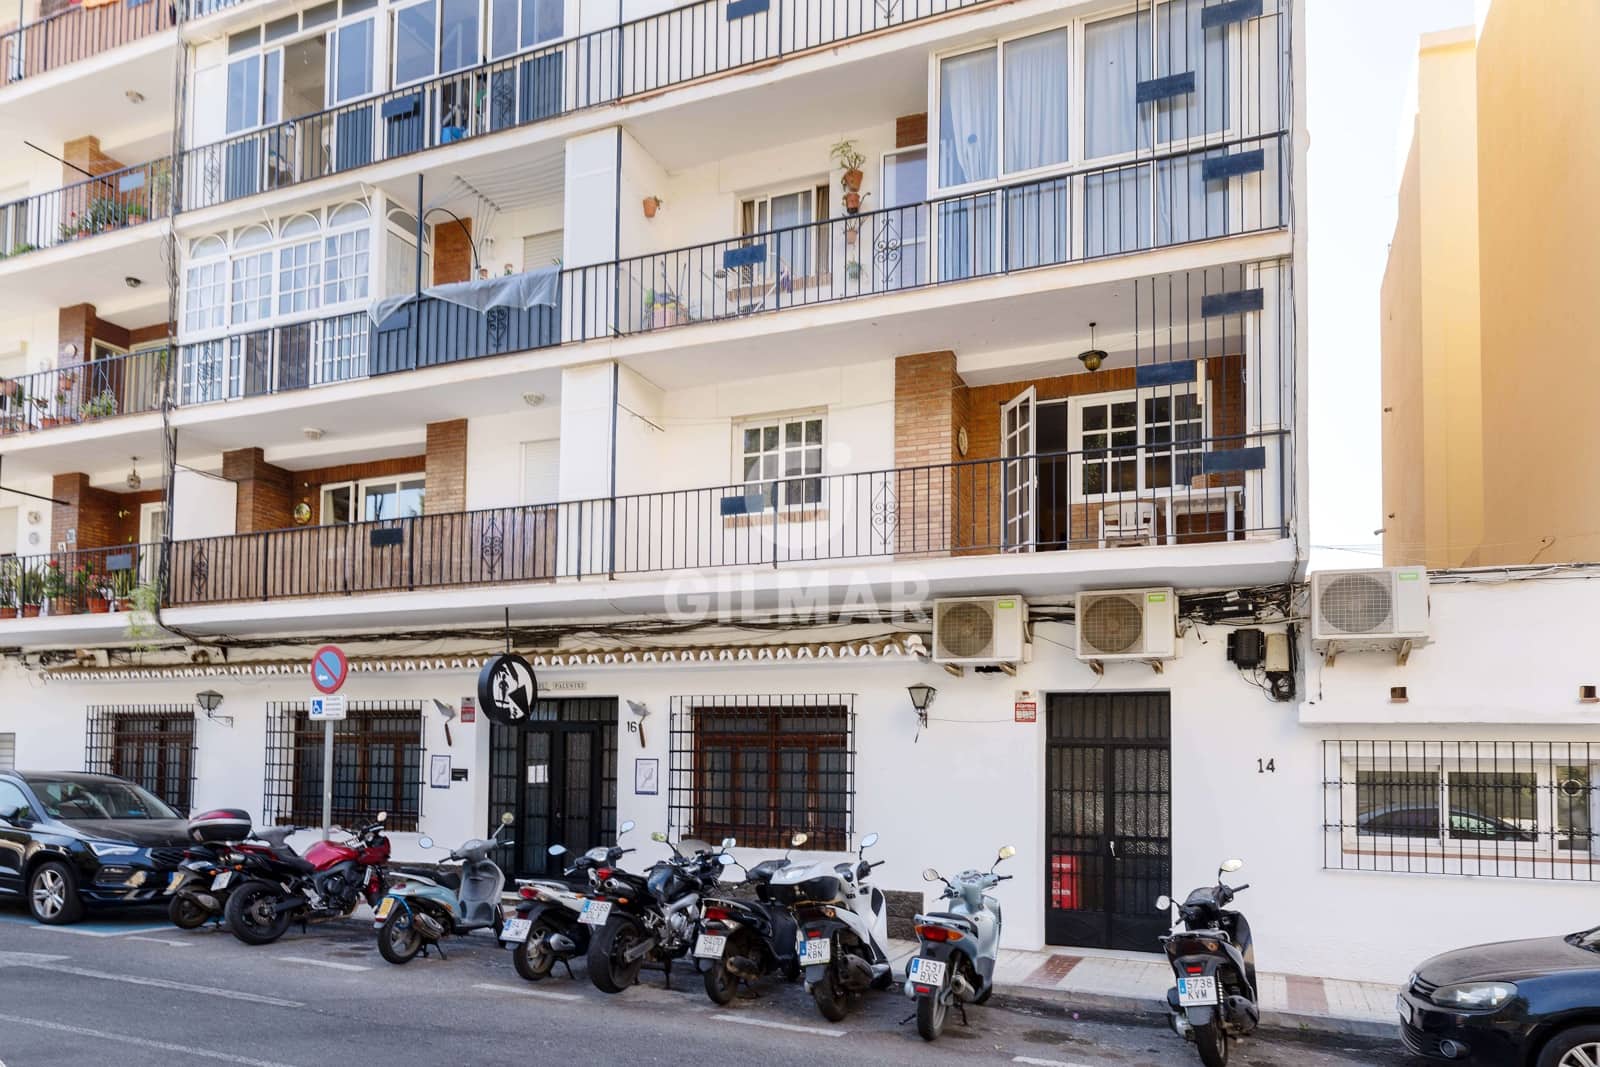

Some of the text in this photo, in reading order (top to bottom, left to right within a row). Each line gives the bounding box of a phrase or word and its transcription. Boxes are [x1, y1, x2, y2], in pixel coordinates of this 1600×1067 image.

[626, 720, 638, 733] 16
[1257, 758, 1276, 773] 14
[807, 951, 823, 960] KBN
[920, 960, 943, 974] 1531
[919, 971, 938, 984] BXS
[1186, 978, 1213, 990] 5738
[1188, 989, 1207, 1000] KVM
